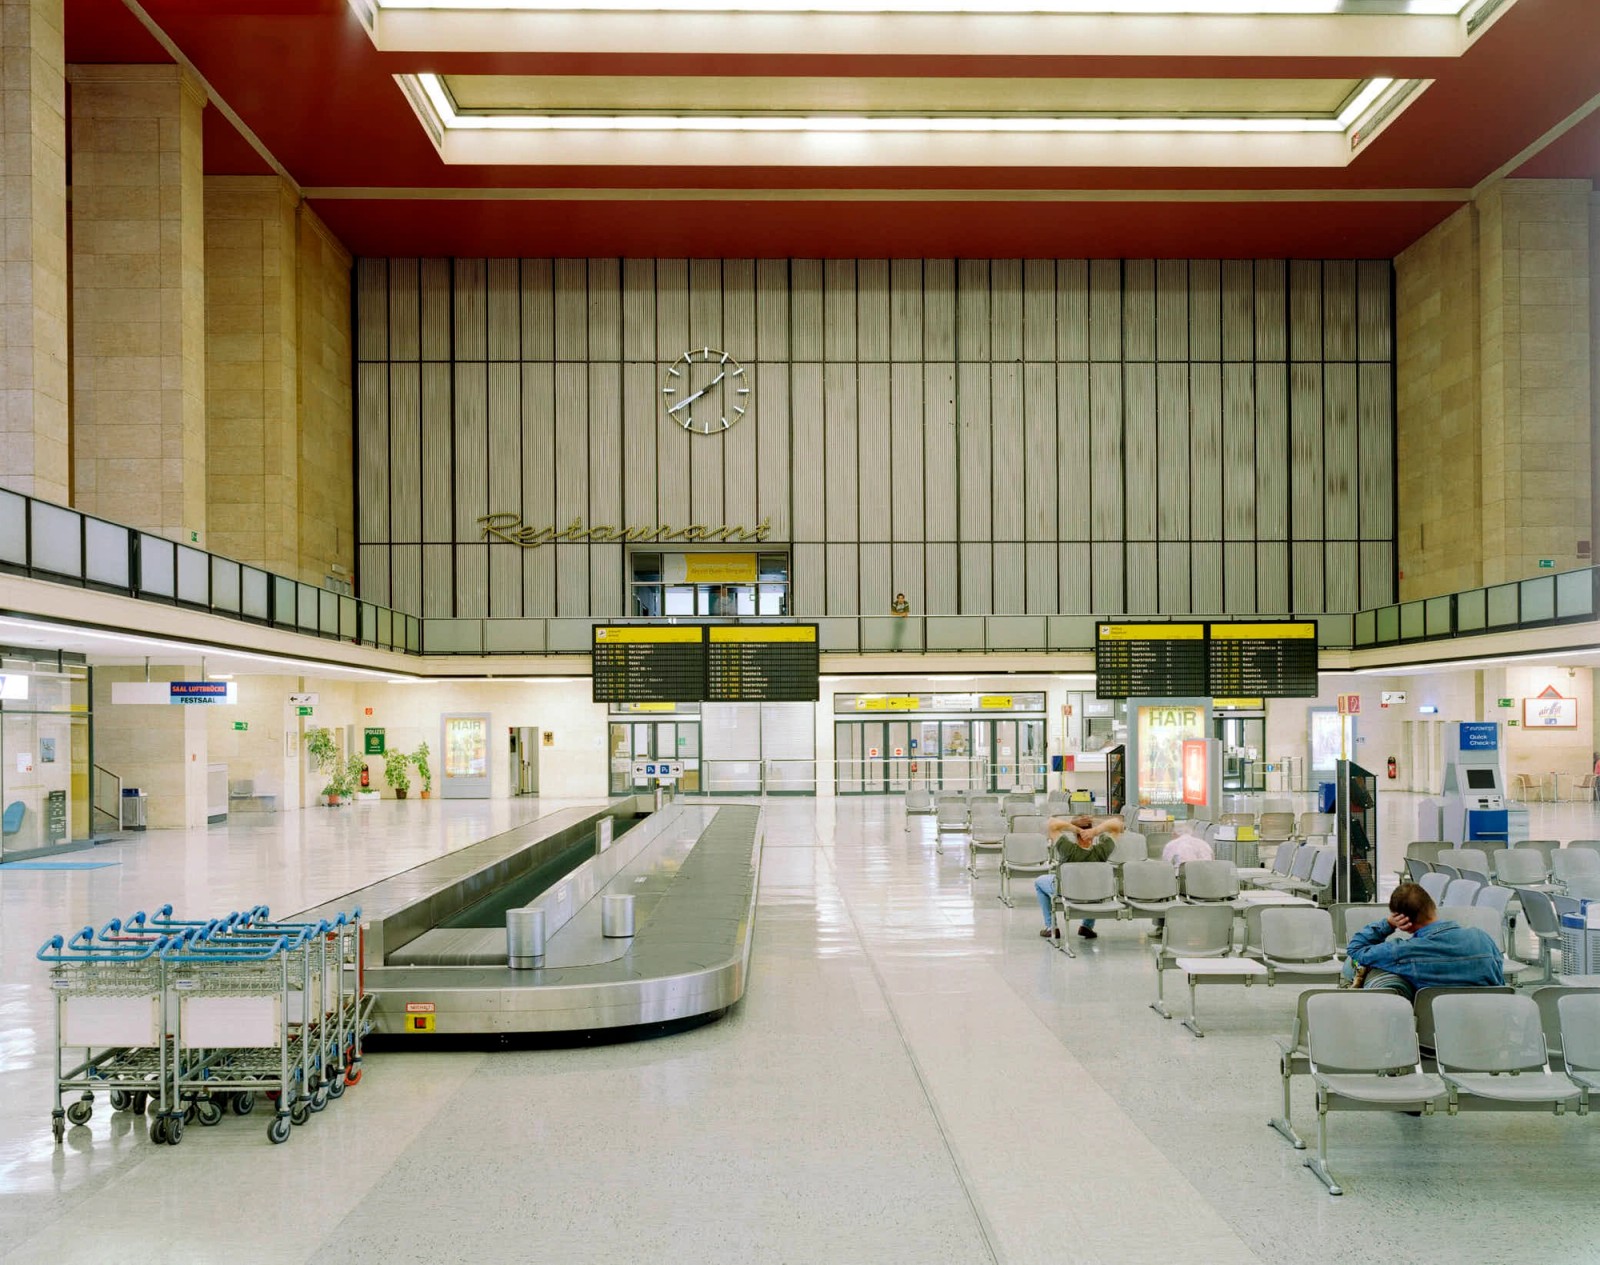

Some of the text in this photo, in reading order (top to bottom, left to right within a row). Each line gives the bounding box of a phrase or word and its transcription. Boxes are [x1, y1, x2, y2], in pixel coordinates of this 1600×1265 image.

[475, 511, 771, 548] Restaurant
[452, 720, 481, 730] HAIR
[1149, 711, 1197, 726] HAIR
